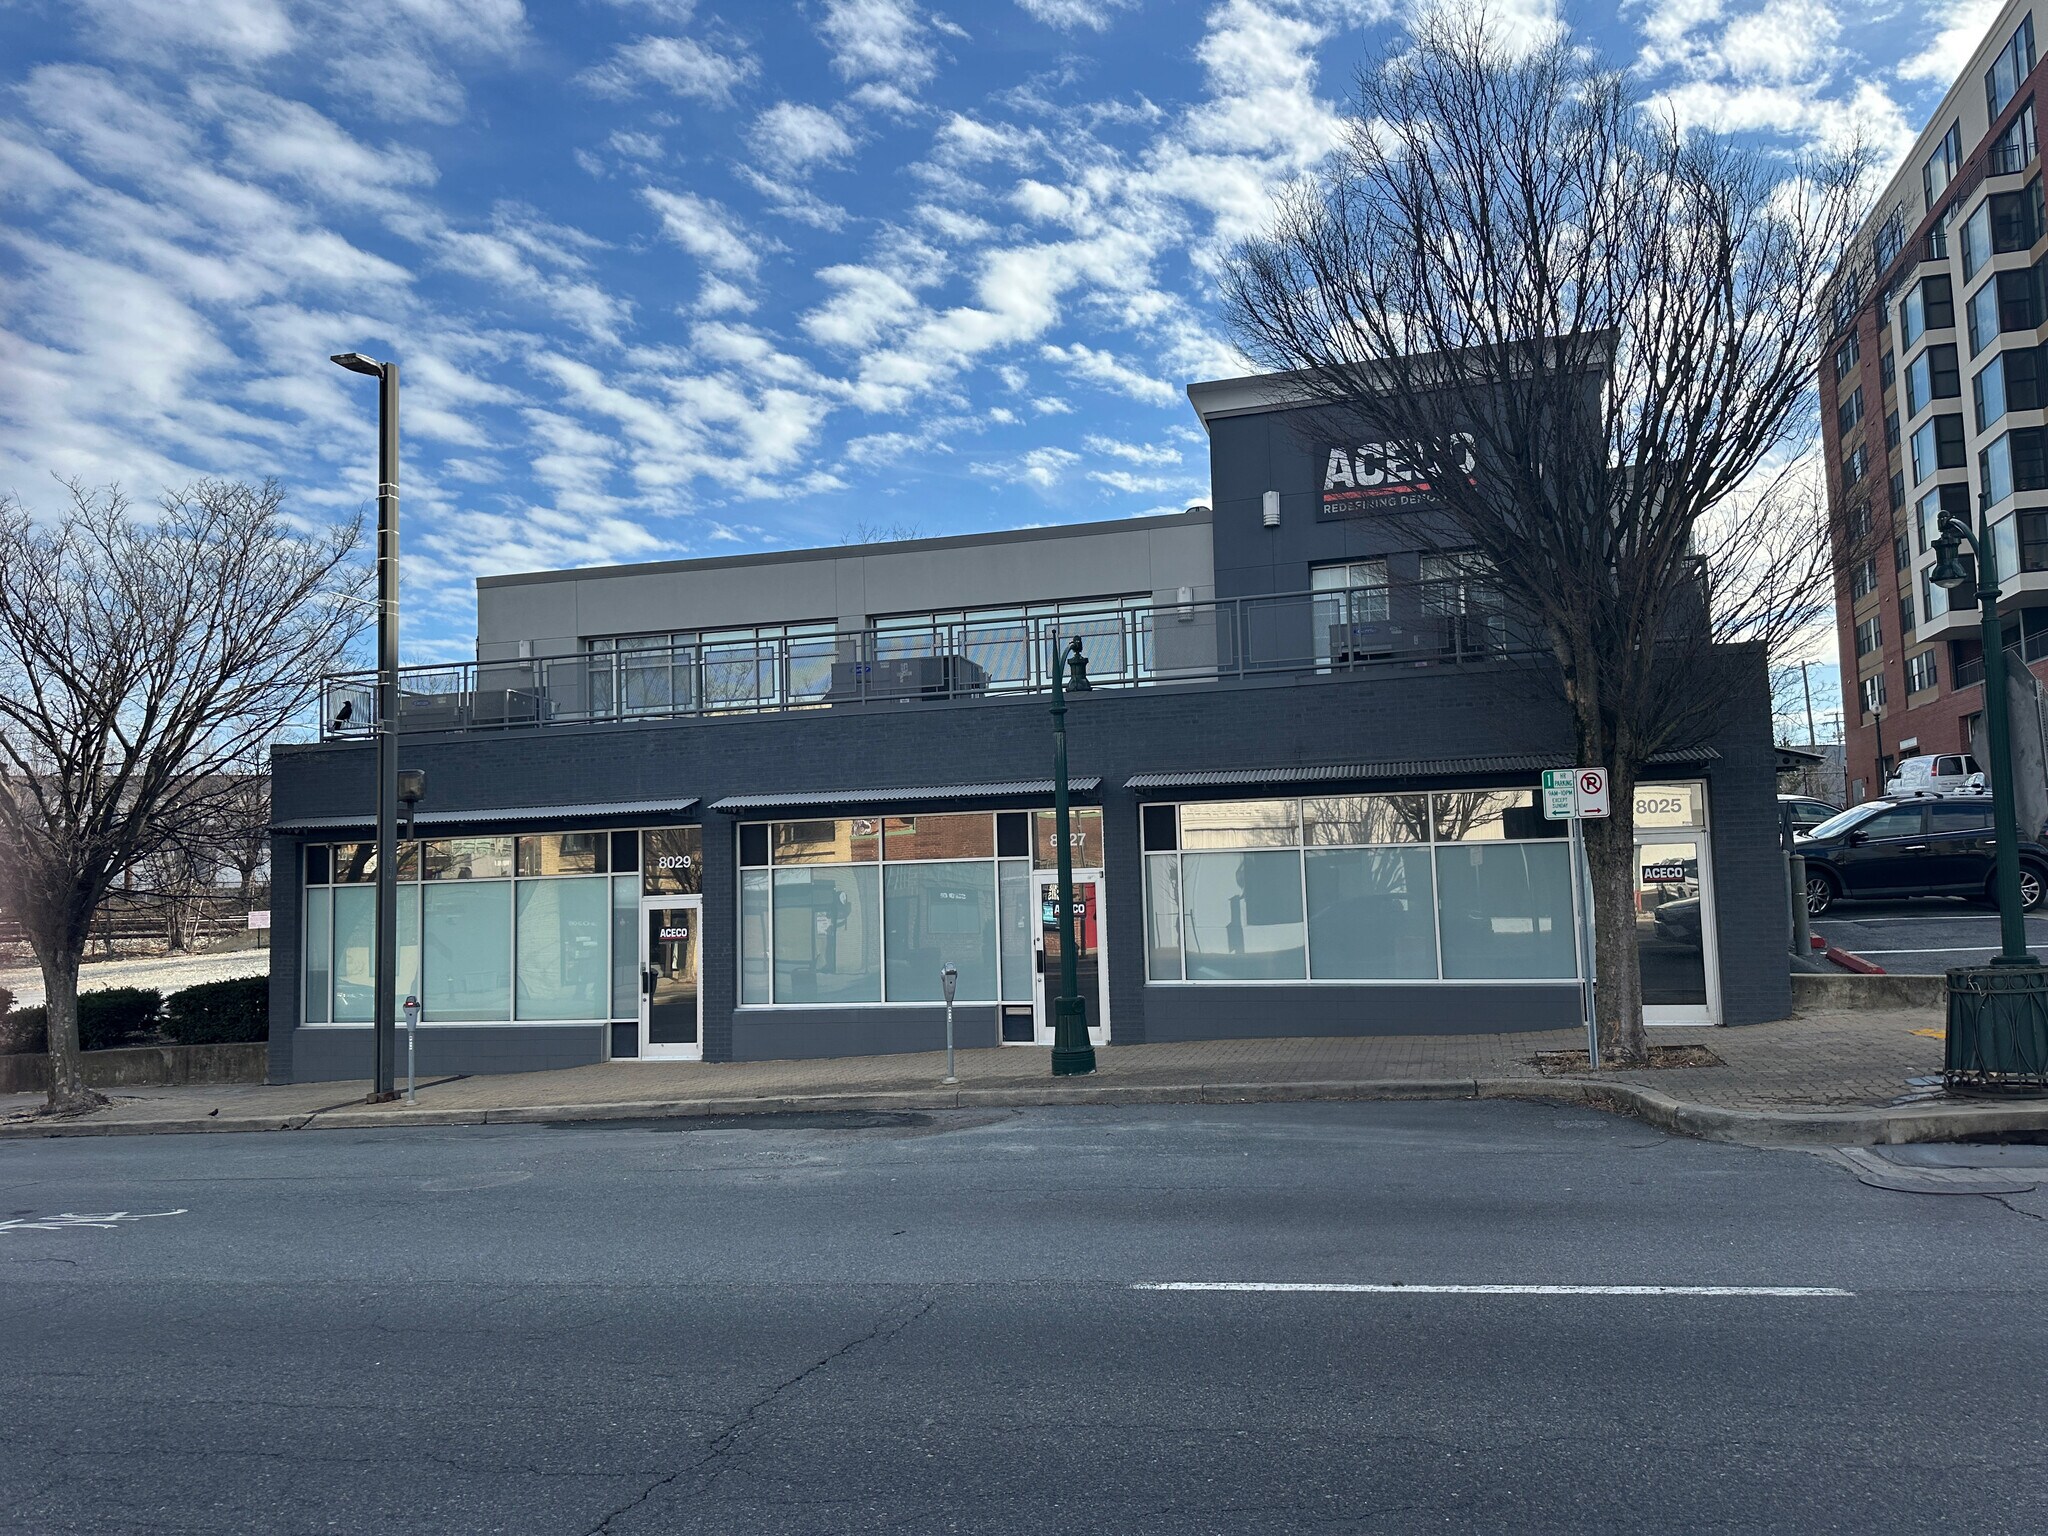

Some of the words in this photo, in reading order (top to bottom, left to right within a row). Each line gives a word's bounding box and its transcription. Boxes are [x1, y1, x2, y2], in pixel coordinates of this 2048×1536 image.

[1323, 497, 1397, 514] REDEFINING
[1546, 774, 1551, 787] 1
[1635, 798, 1682, 814] 8025
[1049, 832, 1087, 847] 827
[658, 855, 691, 869] 8029
[1644, 867, 1683, 879] ACECO
[1054, 904, 1085, 914] ACO
[660, 928, 688, 938] ACECO
